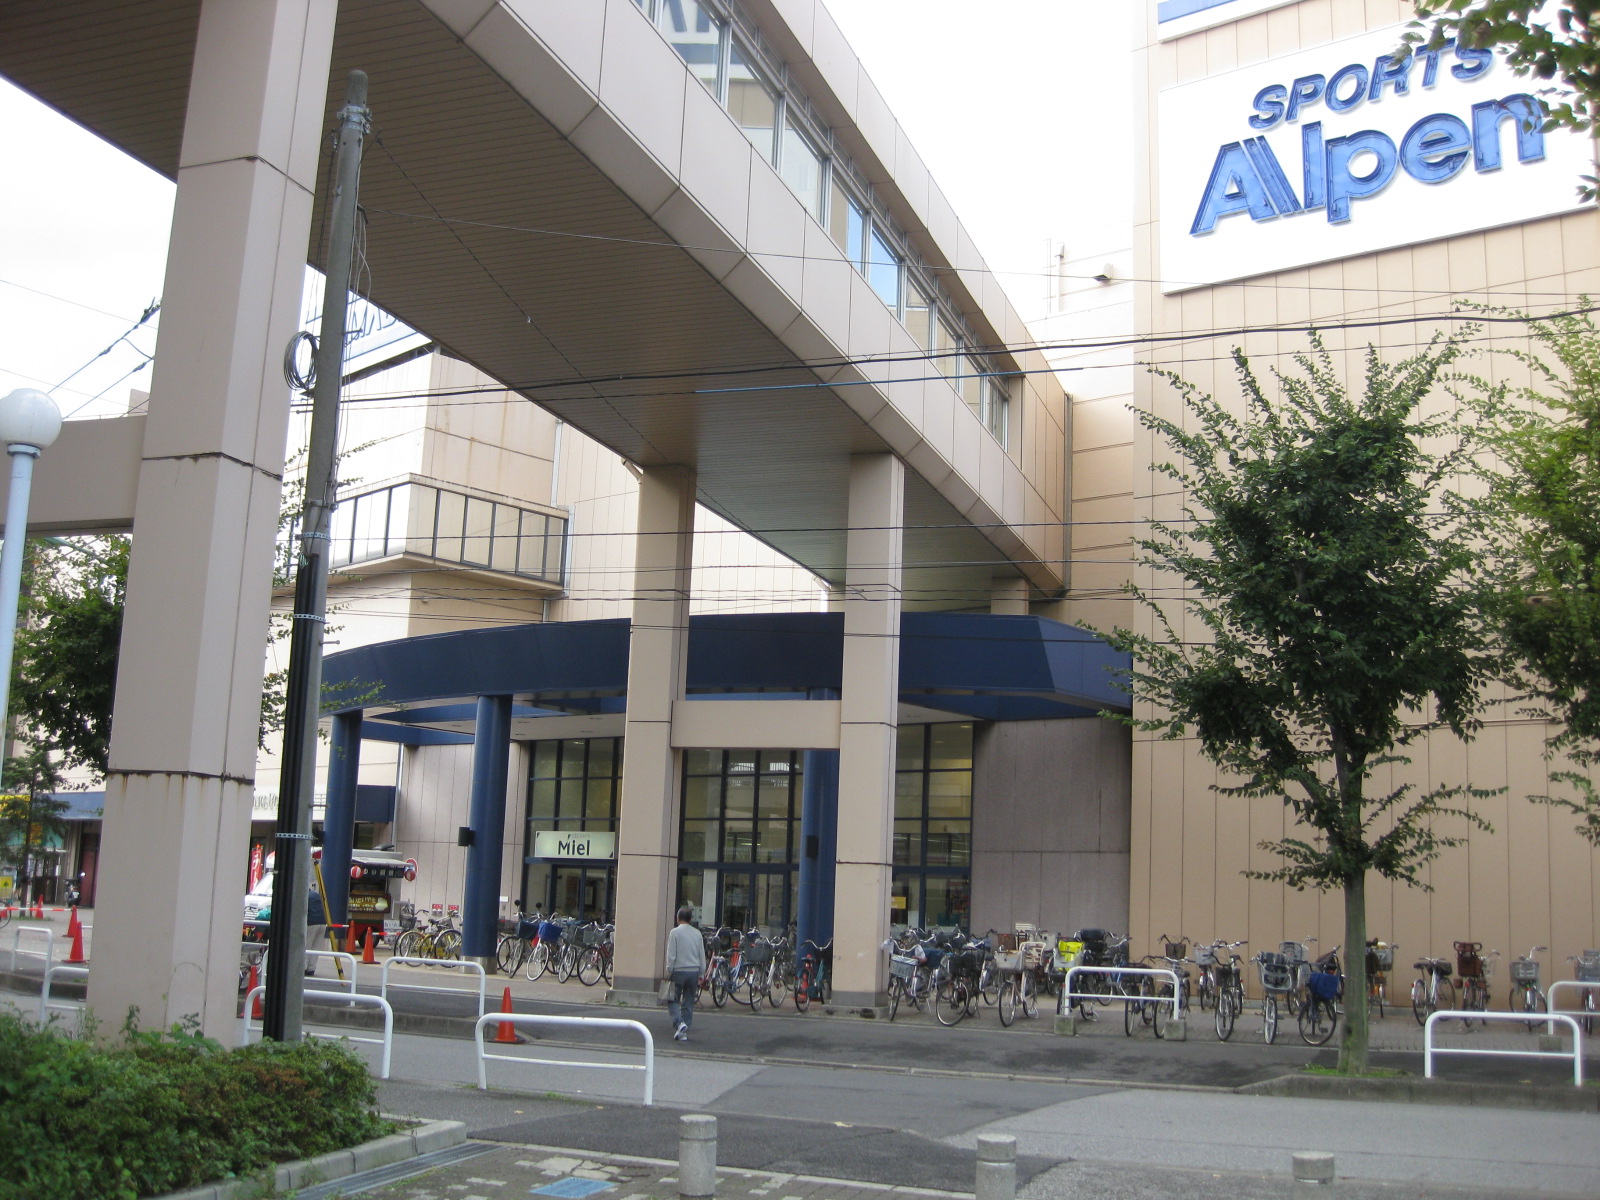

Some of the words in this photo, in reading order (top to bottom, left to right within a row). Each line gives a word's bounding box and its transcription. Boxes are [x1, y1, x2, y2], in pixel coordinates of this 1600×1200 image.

[1248, 38, 1493, 129] SPORTS
[1189, 93, 1546, 235] Alpen
[558, 838, 590, 855] Miel
